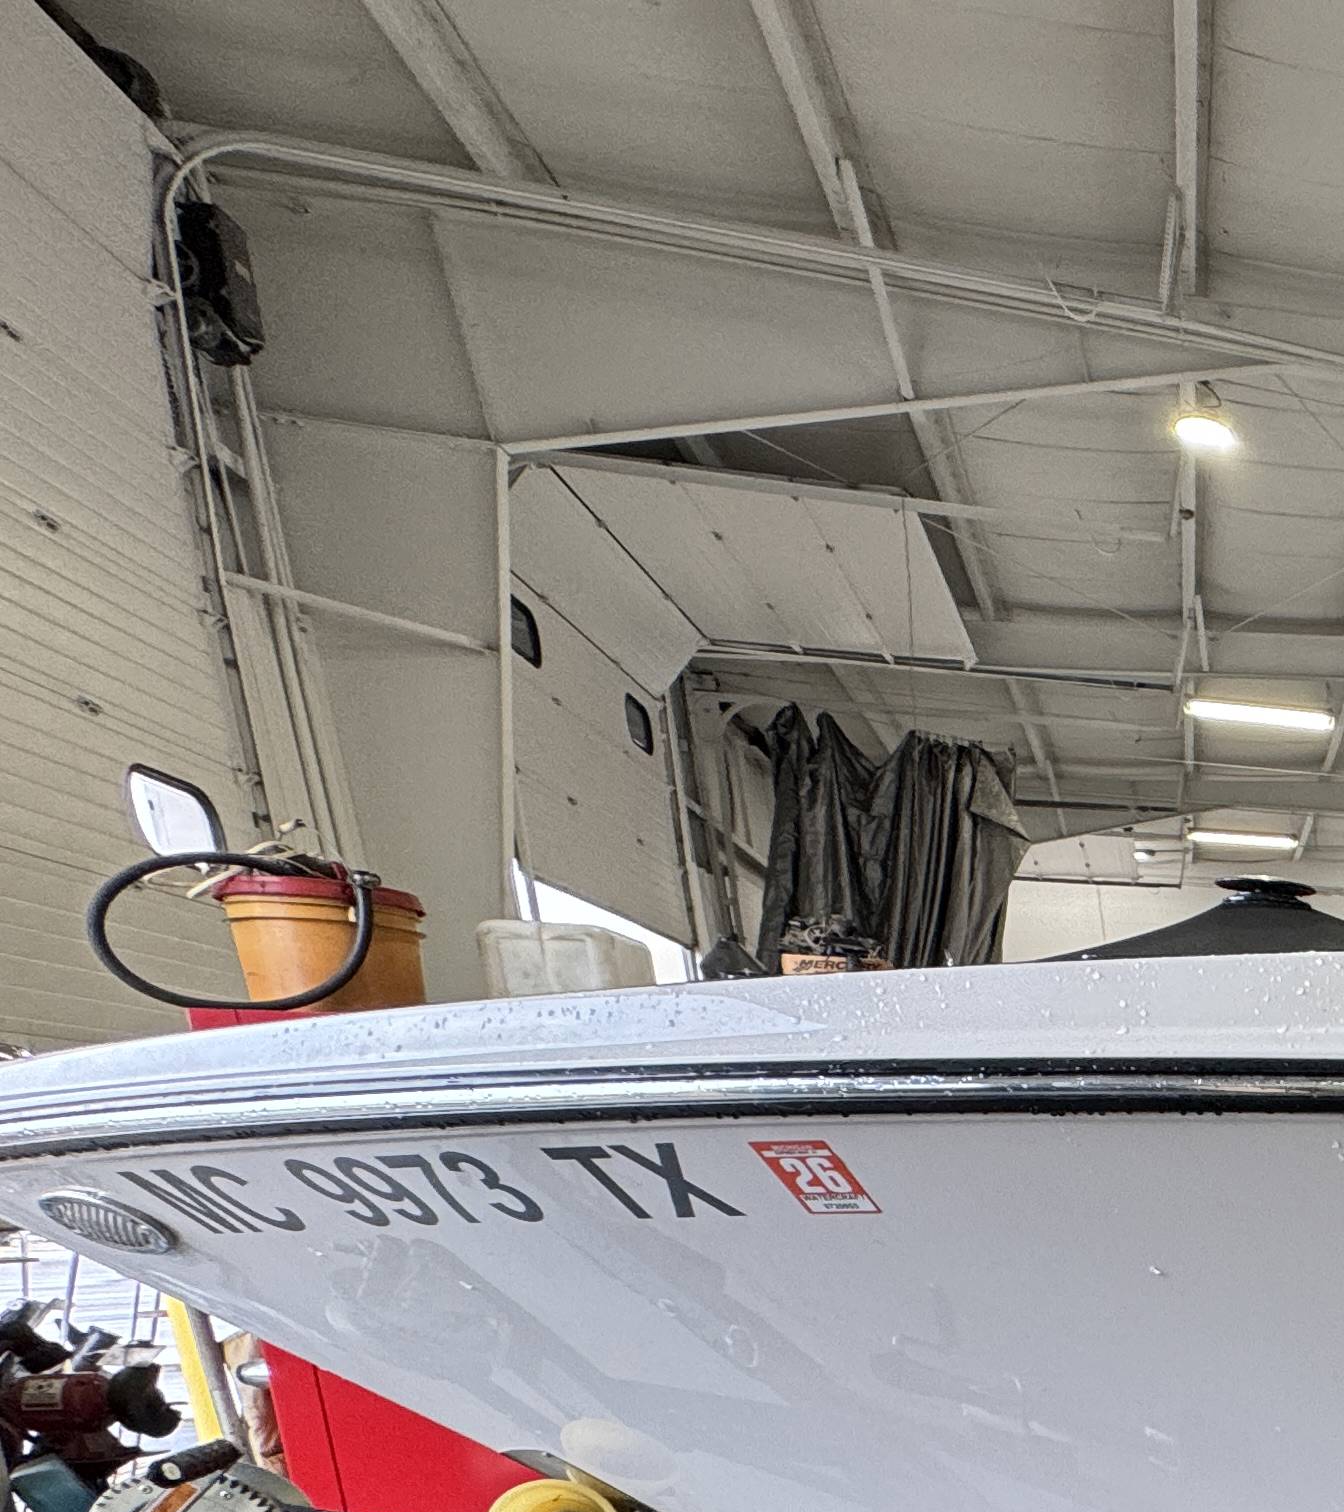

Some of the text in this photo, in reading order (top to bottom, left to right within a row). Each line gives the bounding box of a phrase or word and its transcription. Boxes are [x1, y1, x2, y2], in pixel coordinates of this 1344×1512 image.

[116, 1143, 748, 1234] MC 9973 TX
[779, 1157, 853, 1193] 26
